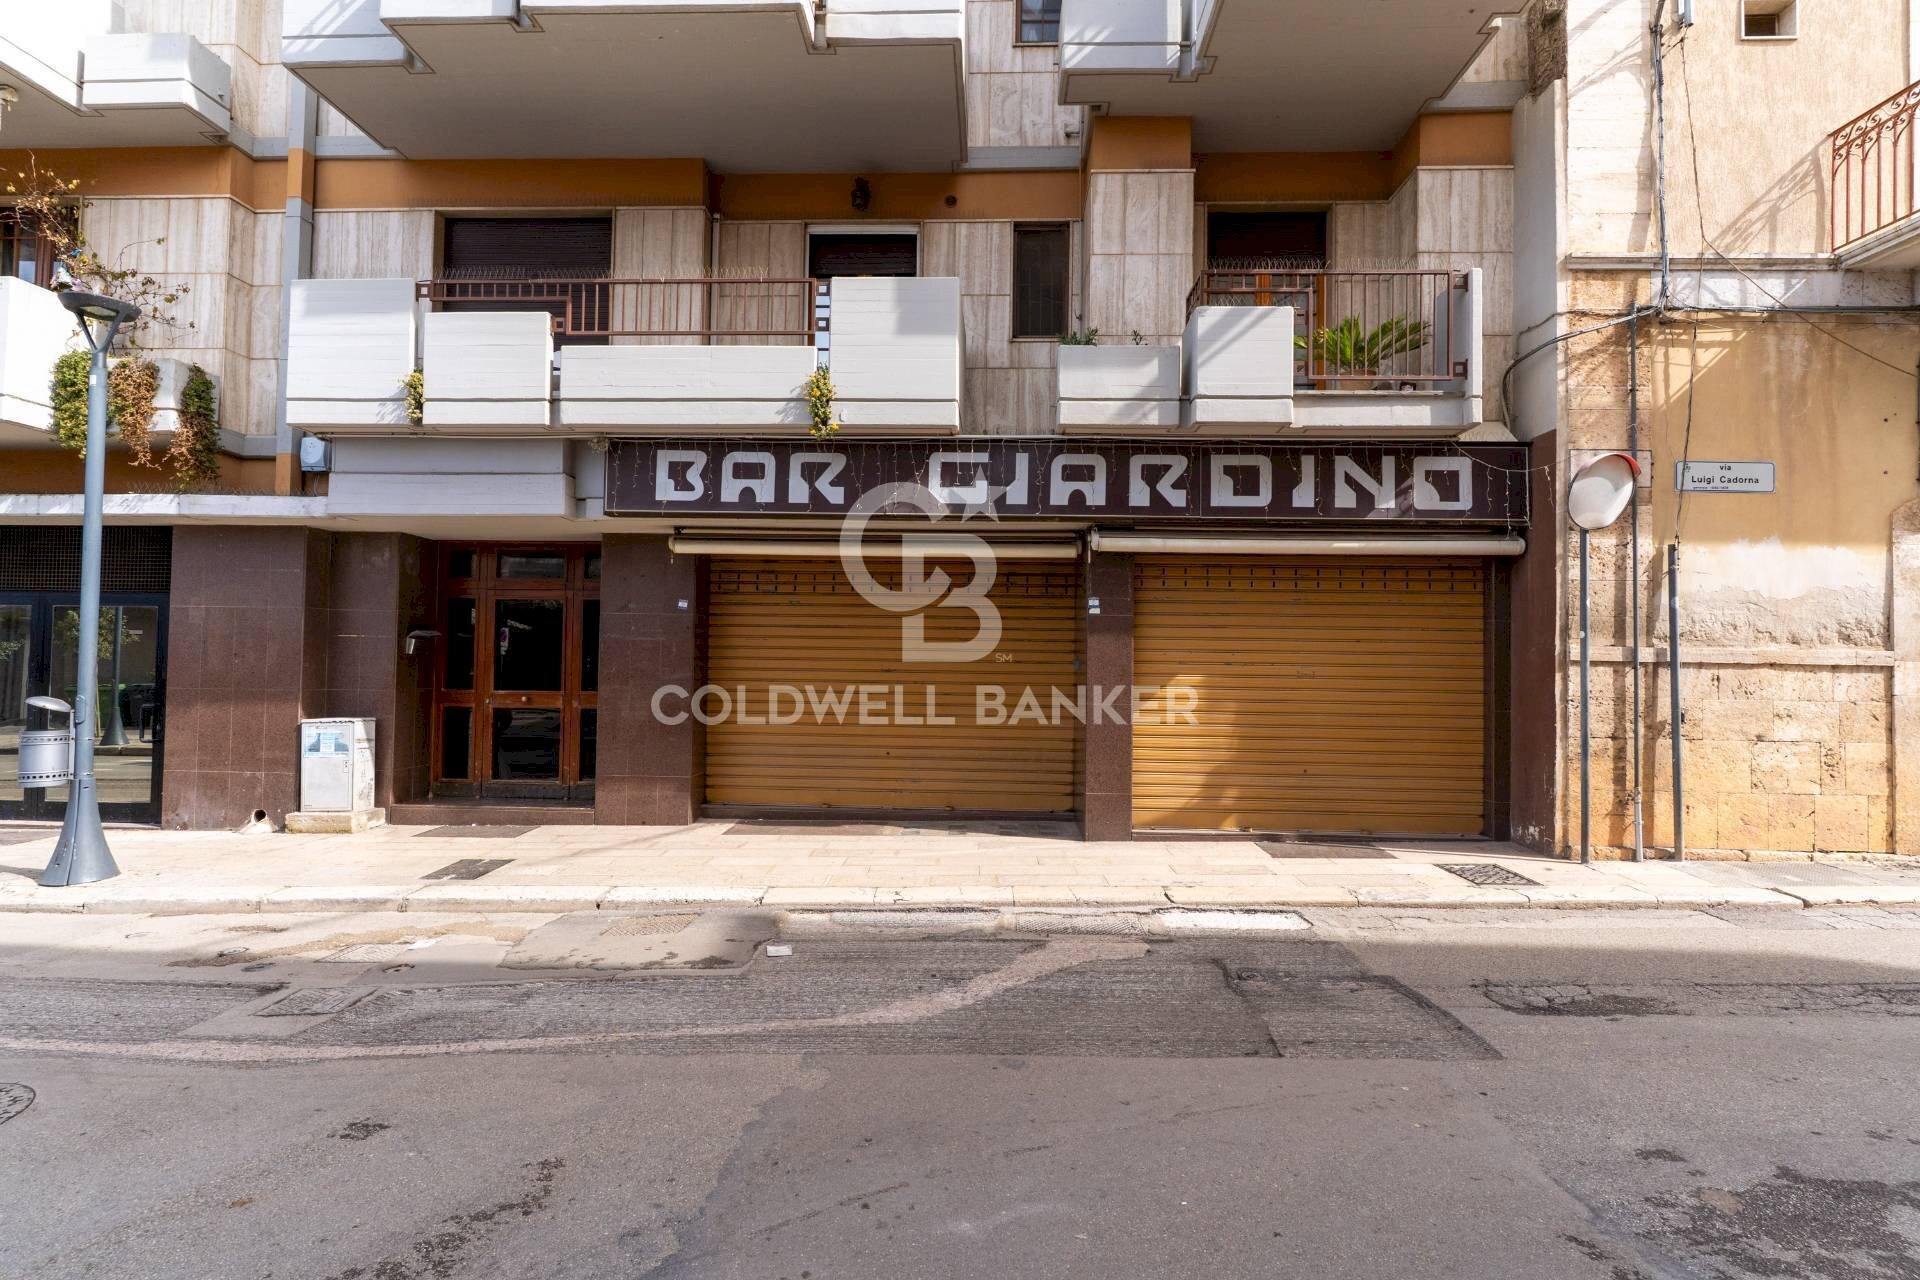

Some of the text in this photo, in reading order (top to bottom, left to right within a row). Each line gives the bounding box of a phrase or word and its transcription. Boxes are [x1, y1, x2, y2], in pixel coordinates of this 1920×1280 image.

[655, 450, 1474, 510] BAR GIARDINO
[1691, 475, 1760, 485] Luigi Cadorna
